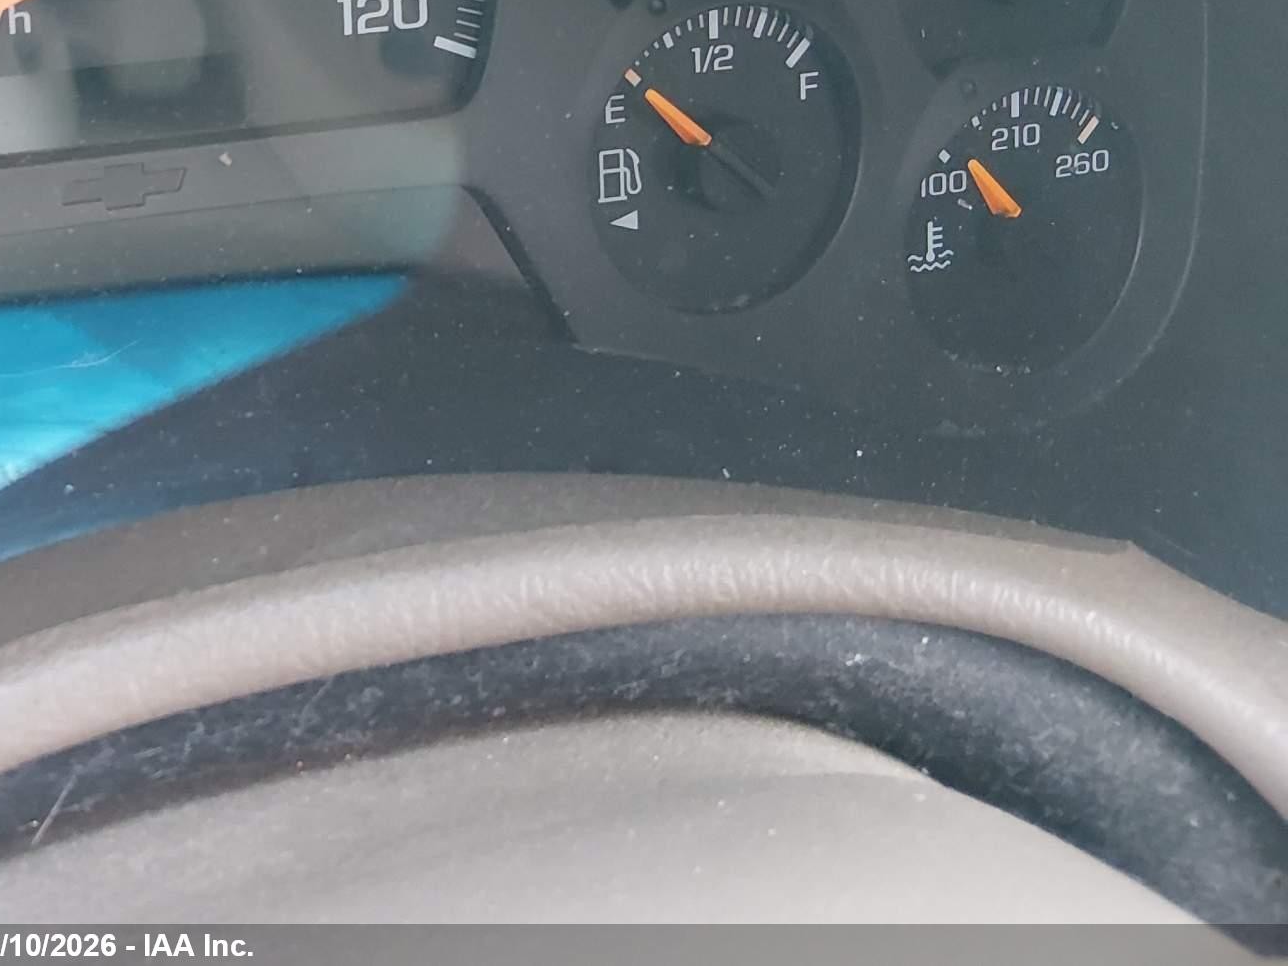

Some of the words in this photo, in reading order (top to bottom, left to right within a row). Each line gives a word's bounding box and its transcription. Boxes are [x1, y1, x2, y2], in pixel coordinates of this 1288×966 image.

[692, 45, 733, 73] 1/2
[800, 72, 818, 100] F
[606, 95, 625, 124] E
[992, 124, 1040, 150] 210
[1056, 150, 1108, 177] 260
[922, 170, 966, 197] 100
